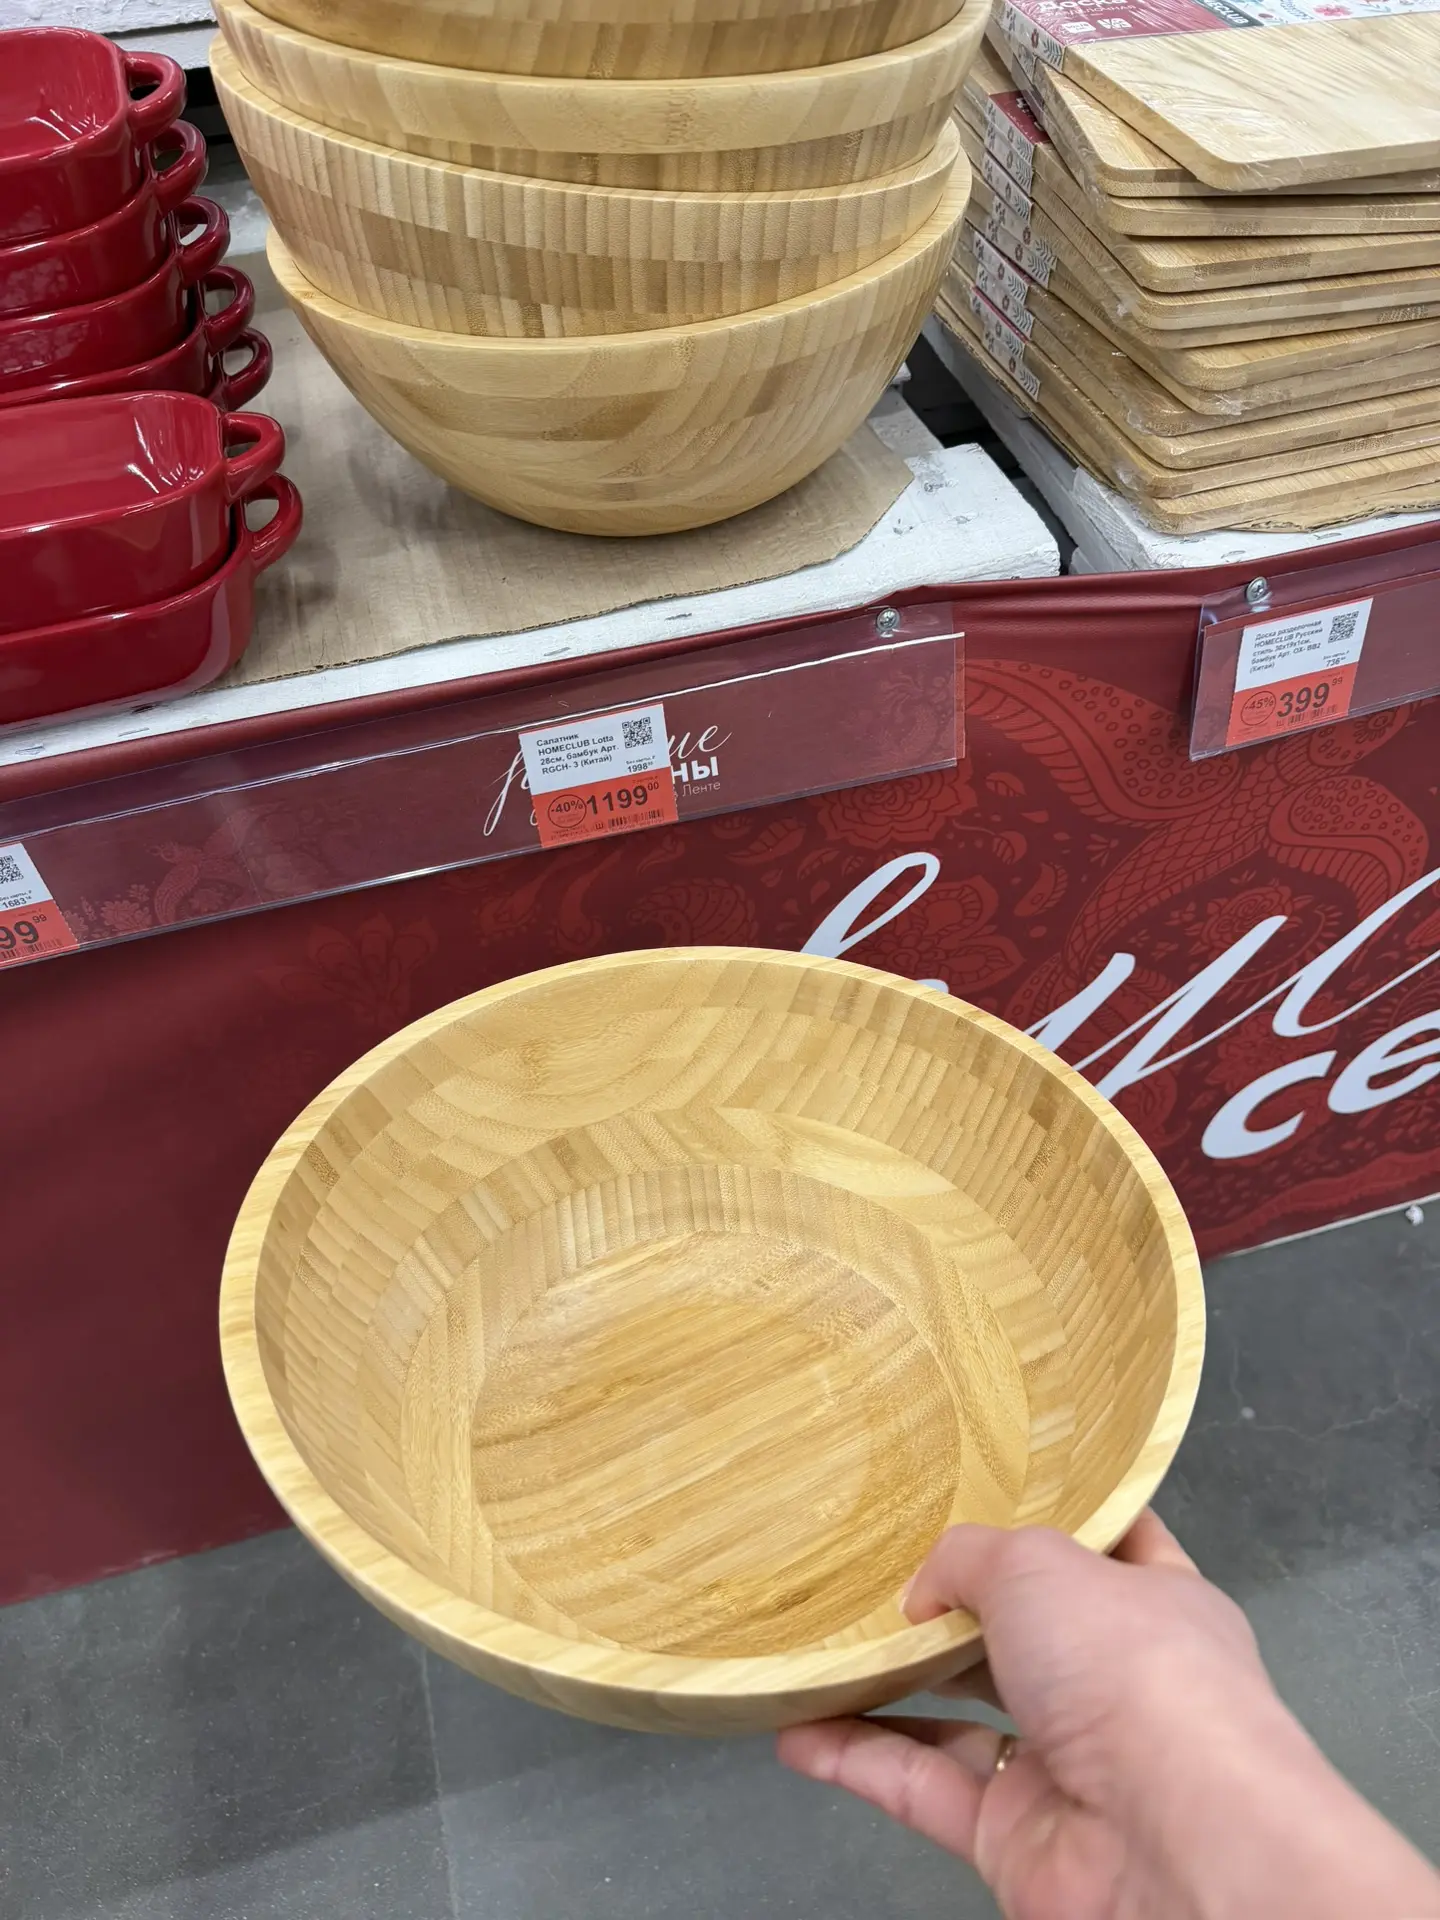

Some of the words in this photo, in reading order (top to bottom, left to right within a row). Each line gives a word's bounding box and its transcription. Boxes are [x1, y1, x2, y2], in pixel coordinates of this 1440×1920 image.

[1254, 634, 1294, 648] HOMECLUB
[1245, 696, 1274, 710] -45%
[1277, 682, 1330, 717] 399
[536, 733, 579, 747] Салатник
[538, 739, 590, 756] HOMECLUB
[592, 735, 614, 745] Lotta
[566, 748, 598, 760] бамбук
[601, 744, 620, 753] Арт.
[542, 763, 572, 775] RGCH-
[580, 754, 612, 767] (Китай)
[628, 762, 648, 773] 1998
[682, 781, 721, 797] Ленте
[550, 800, 584, 814] -40%
[587, 785, 648, 815] 1199
[3, 897, 27, 908] 1683
